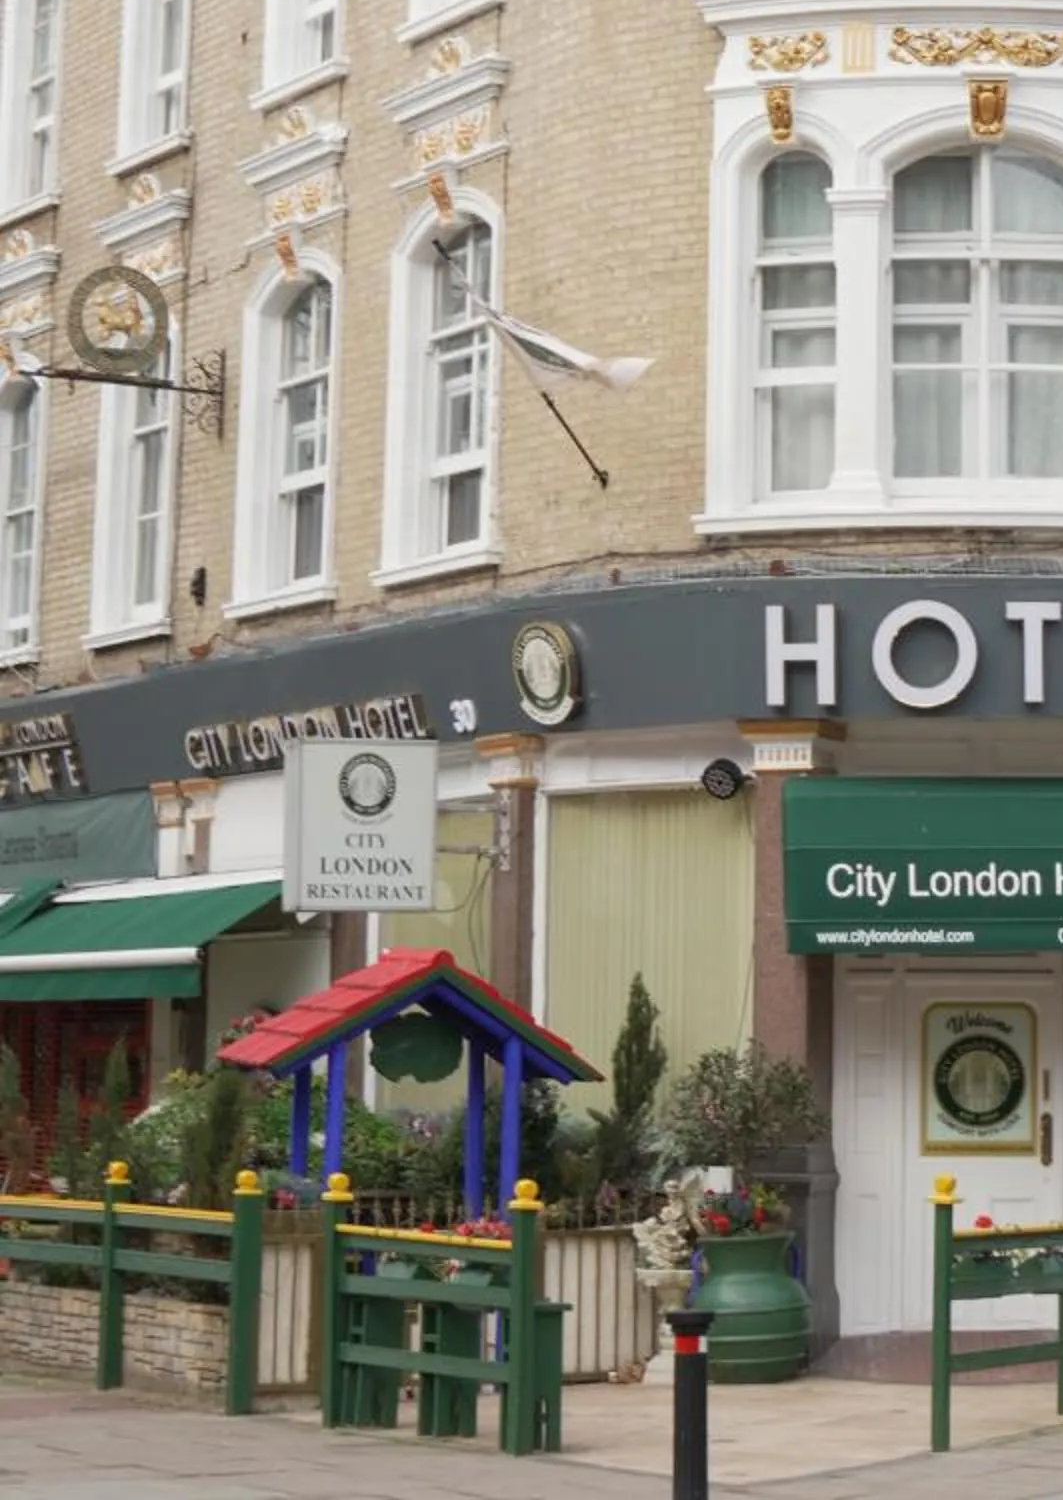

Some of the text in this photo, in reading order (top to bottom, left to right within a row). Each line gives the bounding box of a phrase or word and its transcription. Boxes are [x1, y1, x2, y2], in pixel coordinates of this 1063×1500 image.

[450, 699, 476, 733] 30
[185, 695, 428, 769] CITY LONDON HOTEL
[345, 833, 387, 848] CITY
[320, 856, 413, 876] LONDON
[306, 883, 426, 900] RESTAURANT
[826, 863, 897, 906] City
[908, 862, 1041, 897] London
[817, 928, 974, 946] www.citylondonhotel.com
[945, 1011, 1014, 1034] Welcome
